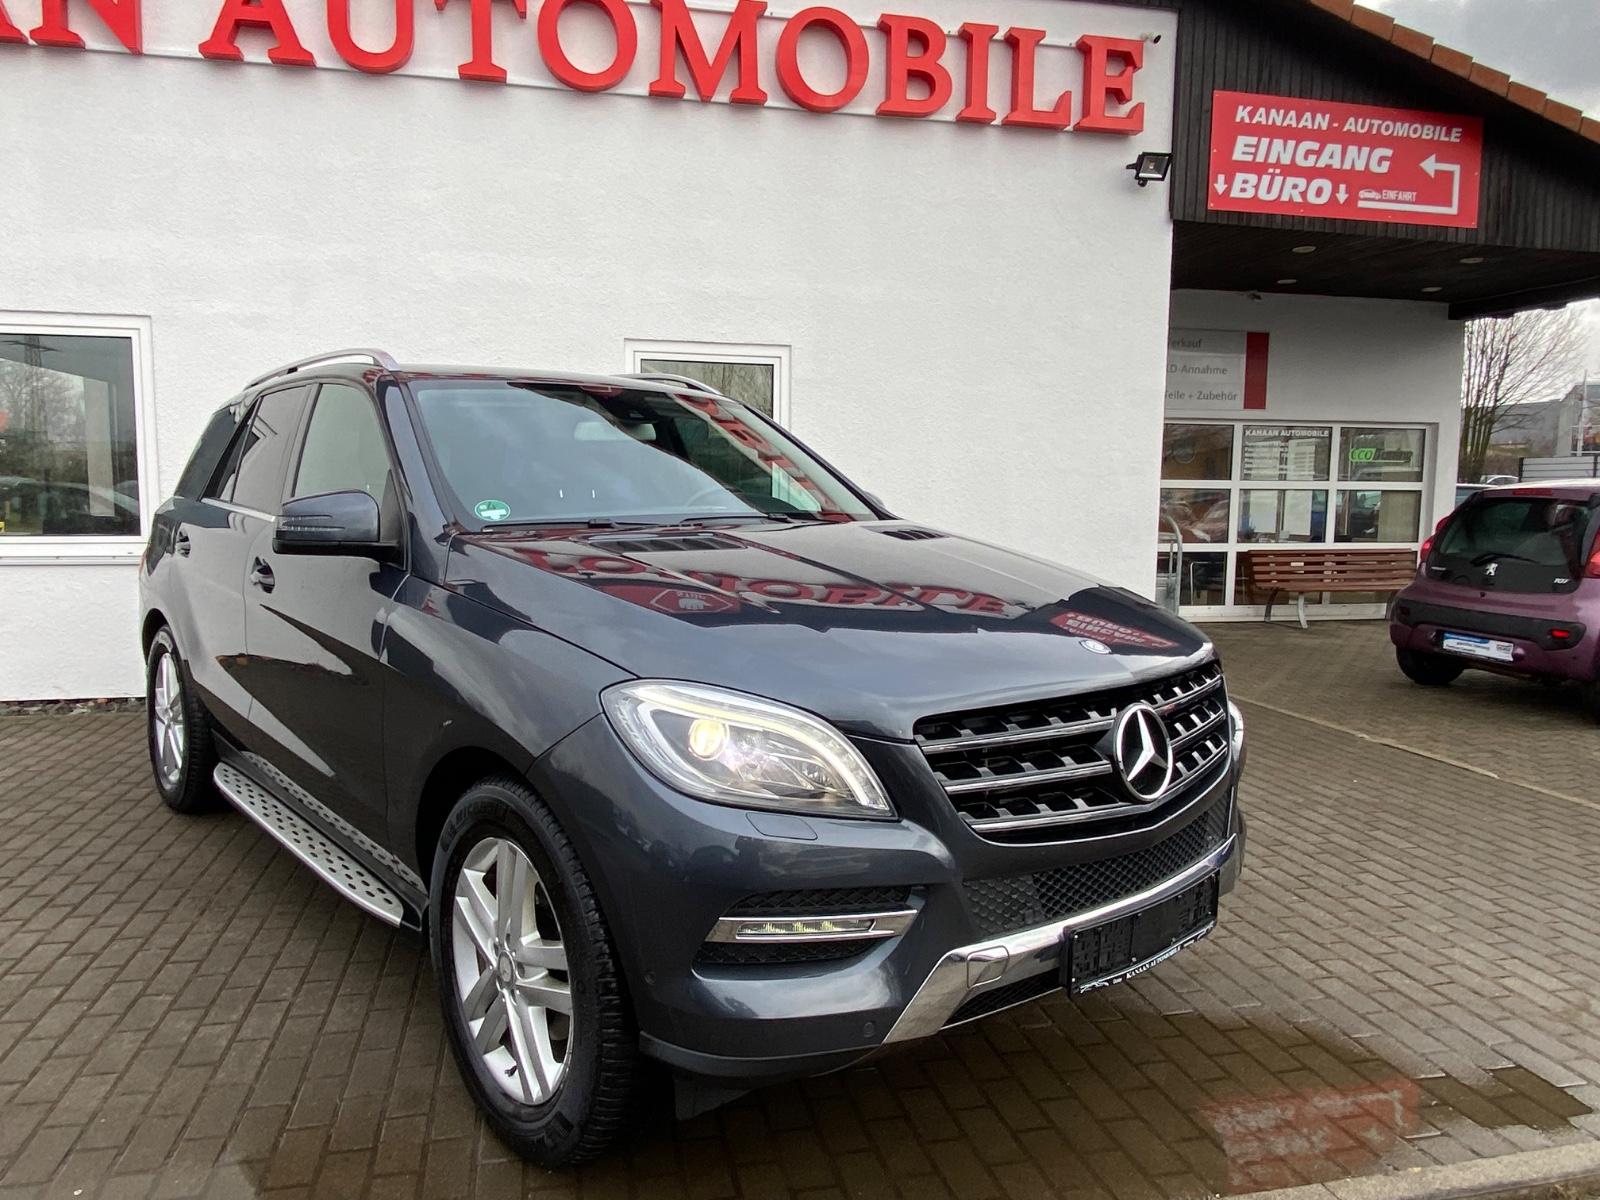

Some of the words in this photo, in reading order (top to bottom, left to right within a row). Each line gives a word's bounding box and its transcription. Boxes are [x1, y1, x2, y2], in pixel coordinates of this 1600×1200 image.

[198, 0, 1145, 136] AUTOMOBILE
[1235, 105, 1330, 131] KANAAN
[1343, 116, 1462, 143] AUTOMOBILE
[1232, 135, 1393, 174] EINGANG
[1230, 168, 1333, 205] BÜRO
[1382, 189, 1418, 203] EINFAHRT
